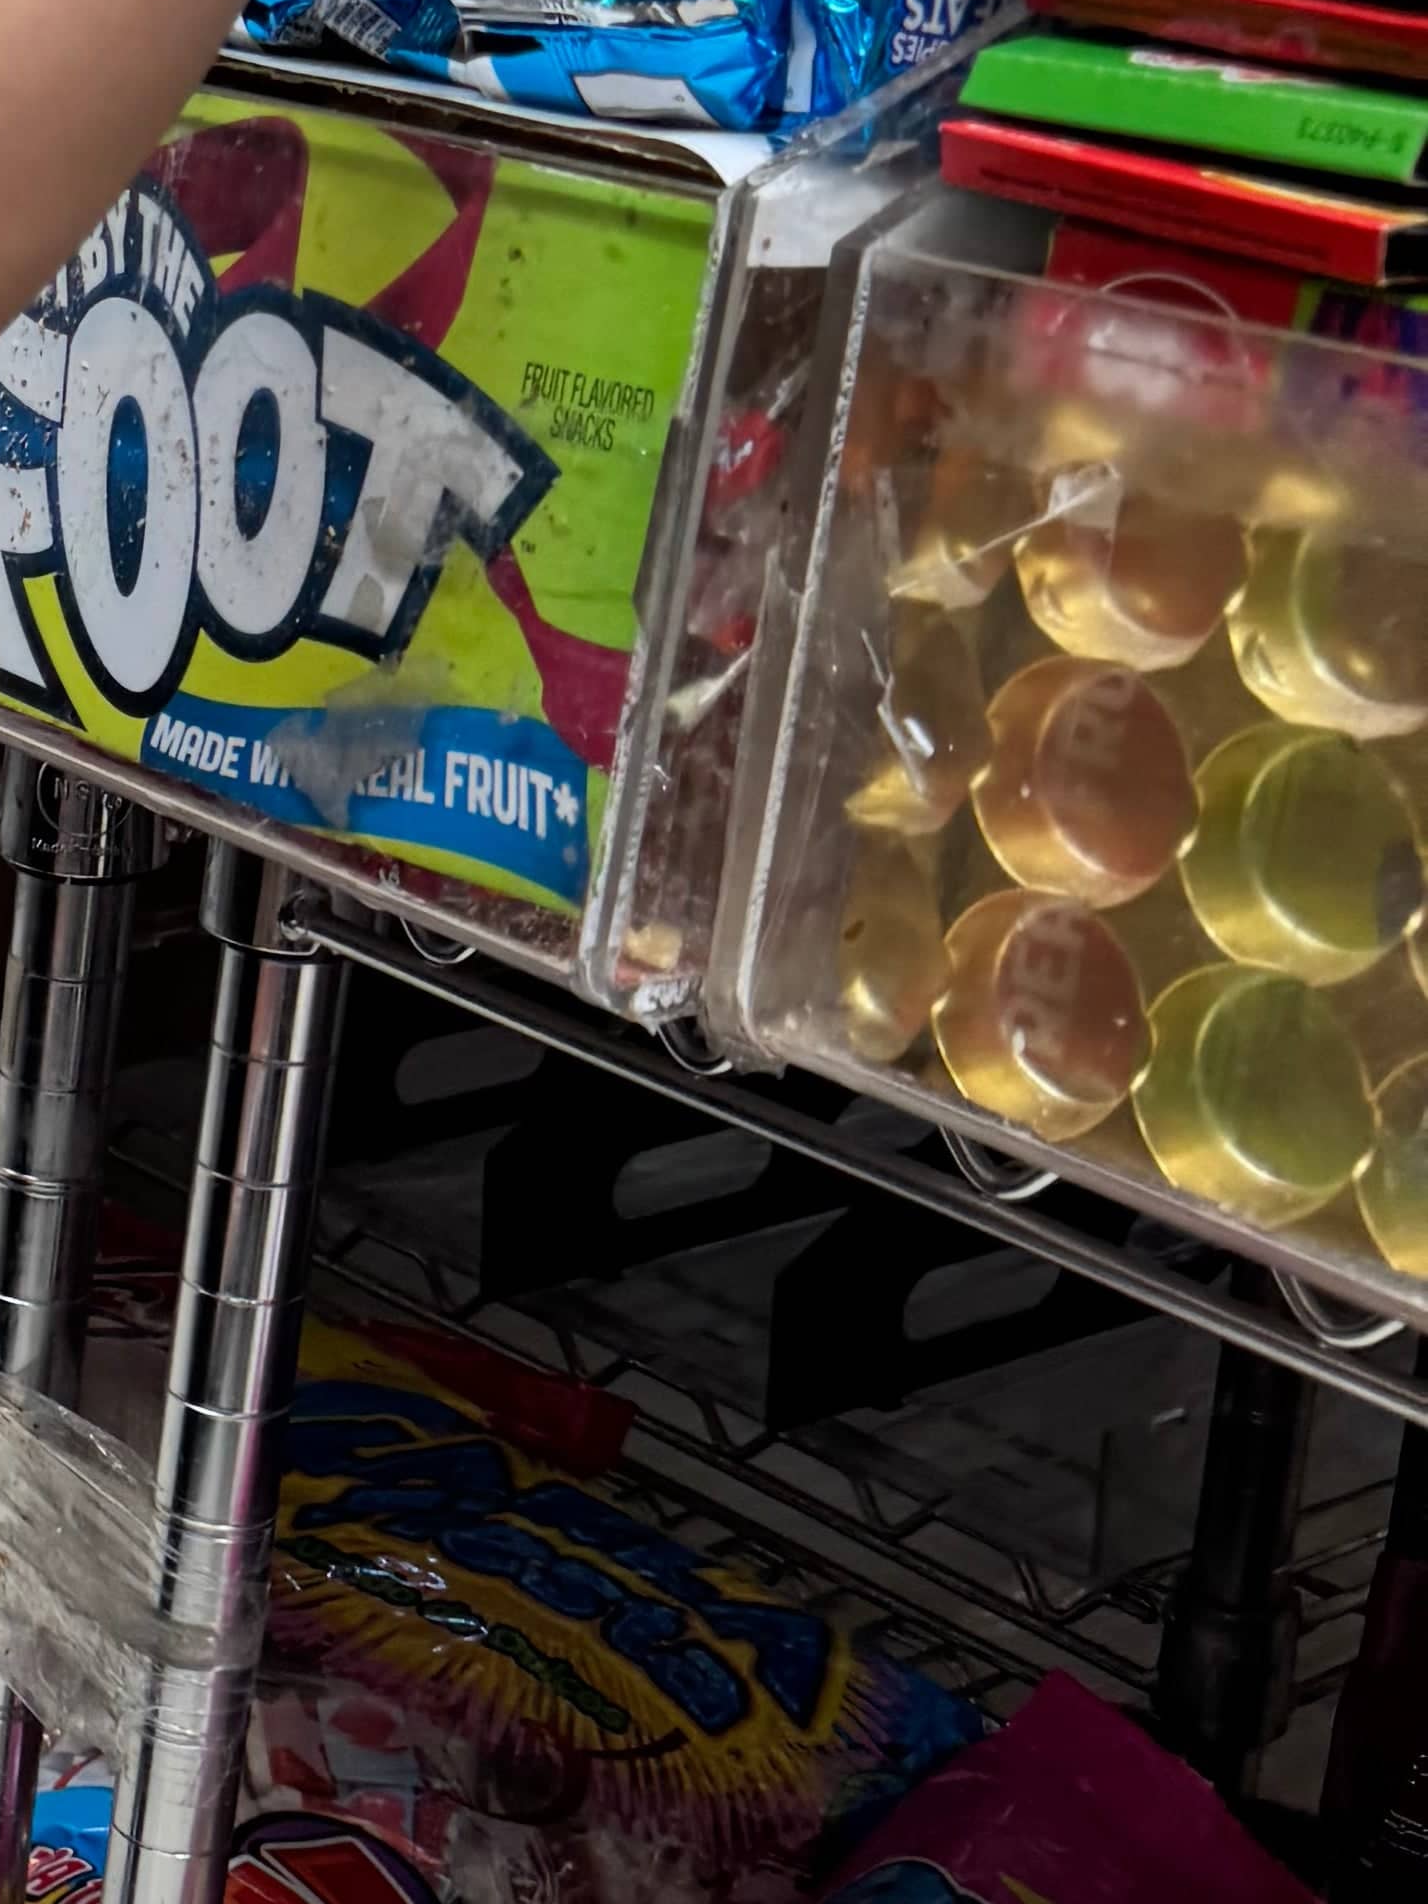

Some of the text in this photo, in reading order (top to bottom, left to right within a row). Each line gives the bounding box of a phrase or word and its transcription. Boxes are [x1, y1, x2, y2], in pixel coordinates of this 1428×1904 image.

[136, 190, 206, 338] THE
[523, 360, 656, 416] FRUIT FLAVORED
[549, 406, 618, 454] SNACKS
[147, 714, 243, 780] MADE
